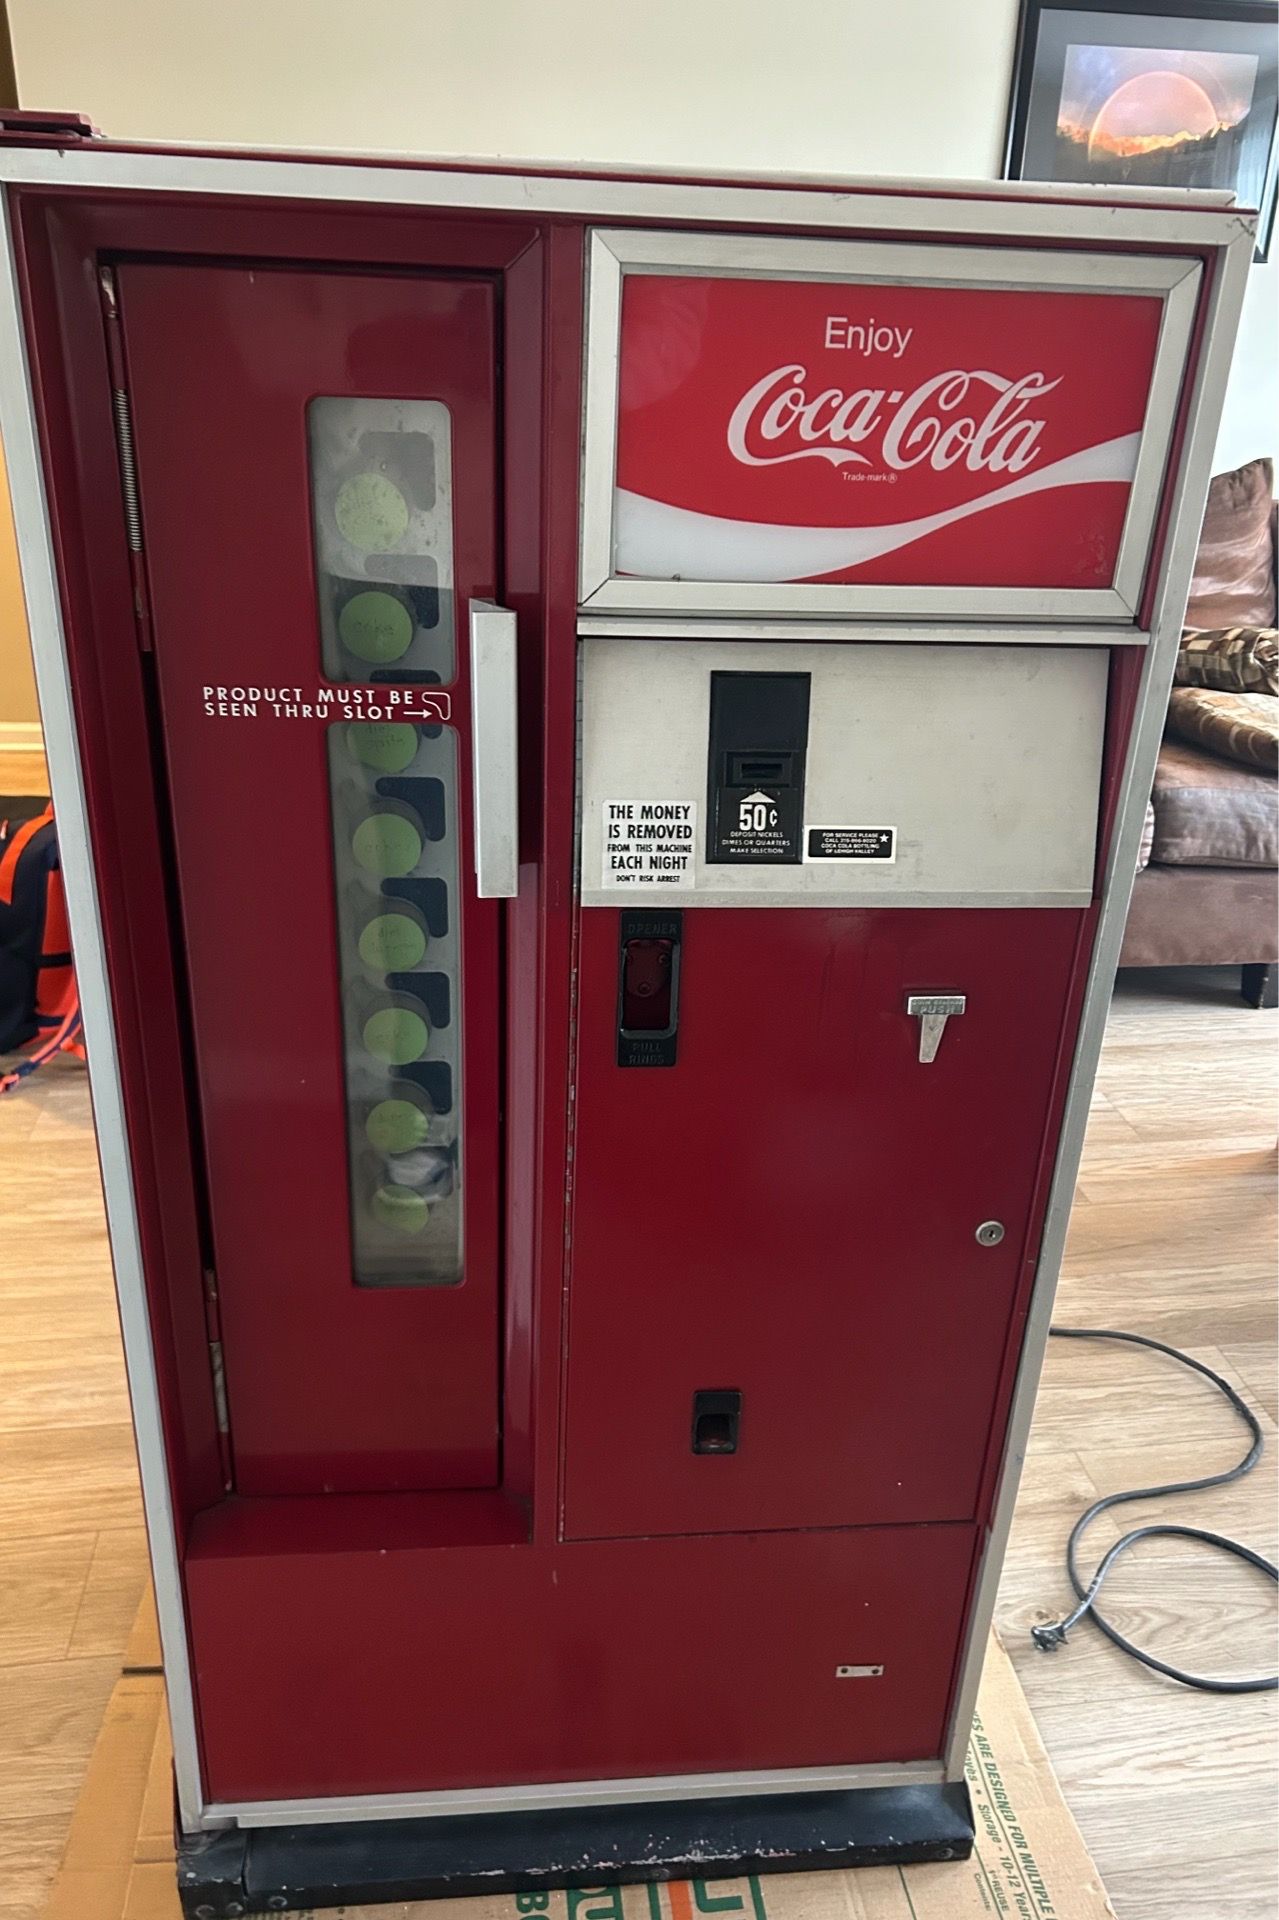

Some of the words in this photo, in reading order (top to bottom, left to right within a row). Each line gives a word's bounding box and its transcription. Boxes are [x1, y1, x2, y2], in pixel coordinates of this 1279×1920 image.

[825, 316, 913, 357] Enjoy
[727, 364, 1064, 472] Coca-Cola
[202, 686, 303, 702] PRODUCT
[318, 689, 376, 704] MUST
[390, 690, 414, 705] BE
[204, 703, 258, 717] SEEN
[273, 704, 329, 718] THRU
[343, 706, 395, 720] SLOT
[608, 804, 634, 819] THE
[640, 805, 691, 820] MONEY
[608, 824, 621, 839] IS
[627, 824, 693, 839] REMOVED
[607, 843, 631, 853] FROM
[635, 843, 653, 853] THIS
[656, 844, 692, 853] MACHINE
[755, 839, 791, 847] QUARTERS
[611, 855, 643, 870] EACH
[649, 856, 688, 870] NIGHT
[627, 923, 678, 935] OPENER
[974, 1734, 994, 1759] ARE
[983, 1763, 1017, 1822] DESIGNED
[977, 1803, 1002, 1843] Storage
[999, 1856, 1021, 1888] 10-12
[1008, 1825, 1029, 1849] FOR
[1019, 1853, 1055, 1914] MULTIPLE
[991, 1880, 1010, 1912] REUSE
